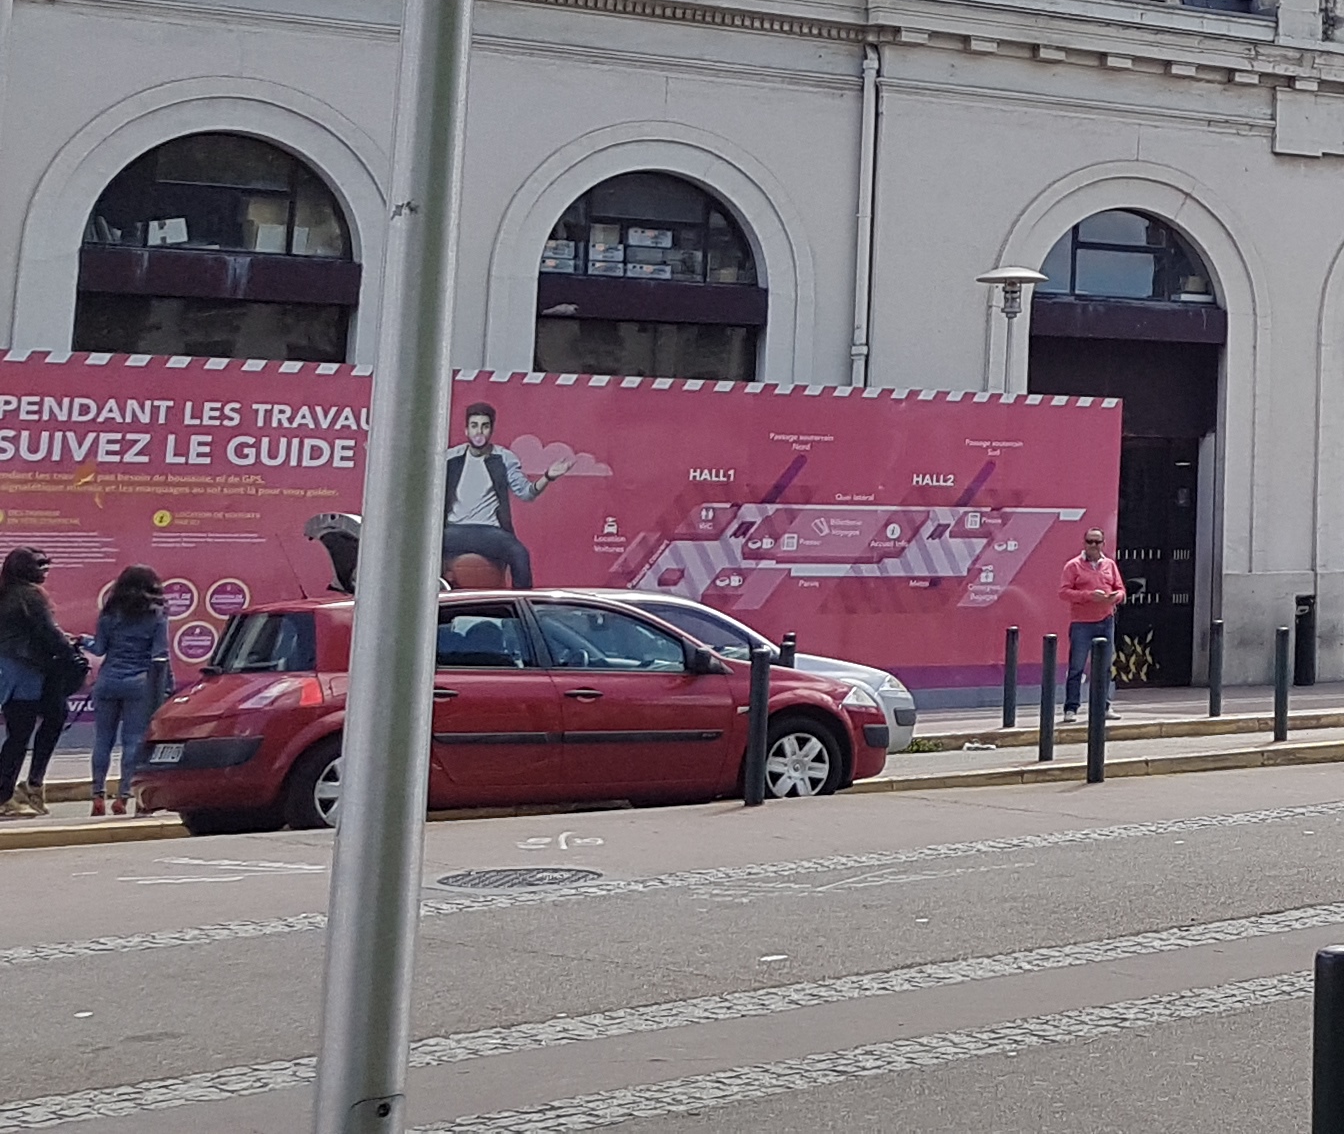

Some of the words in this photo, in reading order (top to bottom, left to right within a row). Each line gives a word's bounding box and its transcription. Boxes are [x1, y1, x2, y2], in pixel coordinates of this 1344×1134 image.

[0, 395, 174, 424] PENDANT
[184, 401, 242, 427] LES
[252, 403, 370, 431] TRAVAU
[0, 429, 151, 463] SUIVEZ
[165, 434, 212, 464] LE
[227, 435, 355, 467] GUIDE
[689, 468, 735, 482] HALL1
[912, 473, 955, 487] HALL2
